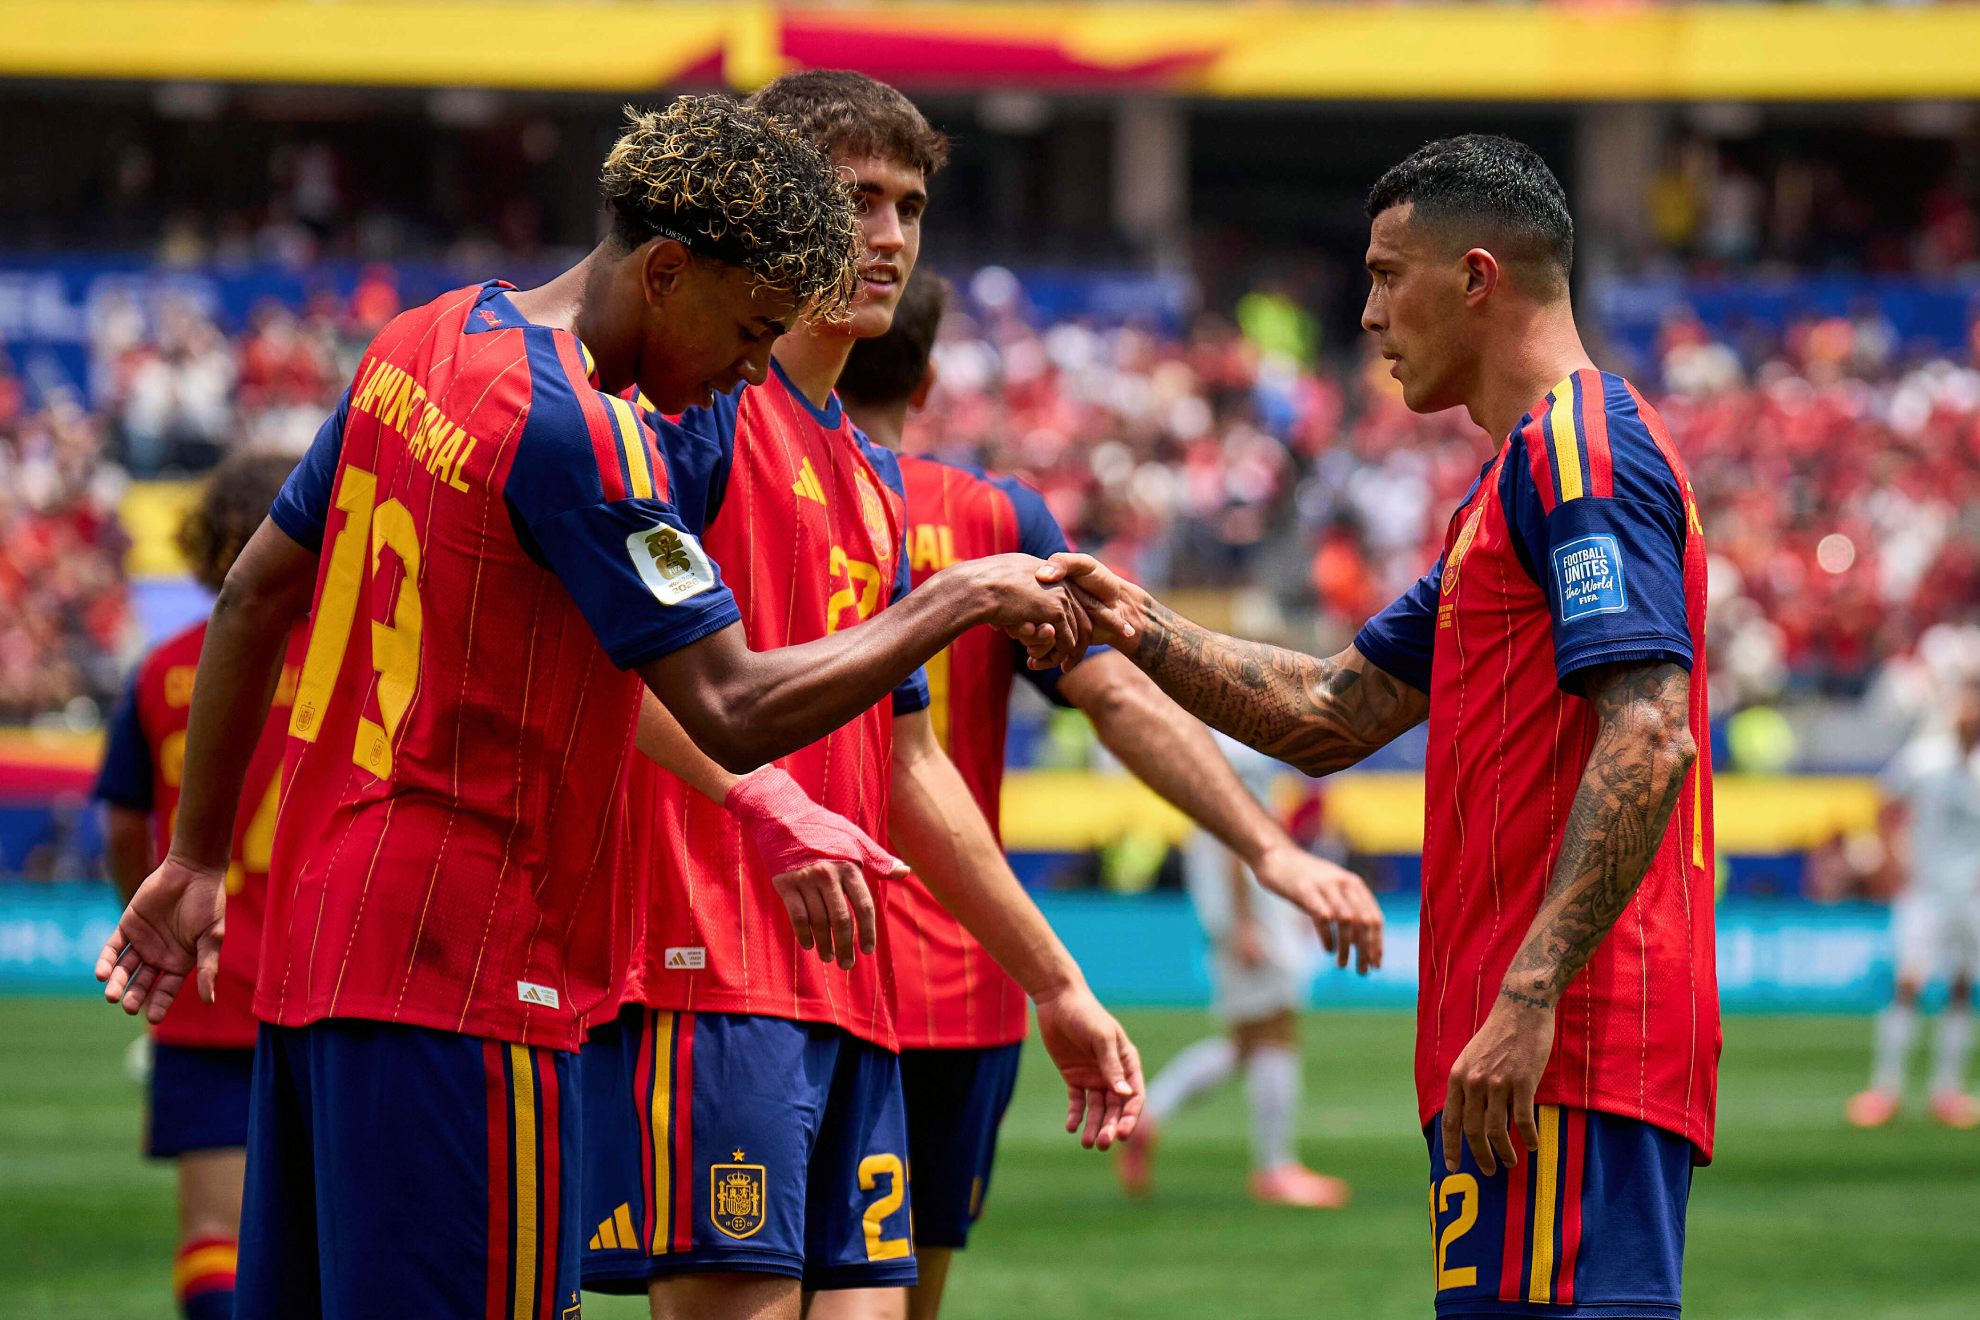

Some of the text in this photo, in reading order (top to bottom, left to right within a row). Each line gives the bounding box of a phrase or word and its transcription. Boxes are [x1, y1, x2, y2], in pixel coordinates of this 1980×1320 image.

[1563, 546, 1607, 568] FOOTBALL
[1565, 559, 1609, 585] UNITES
[1564, 575, 1614, 600] the World
[1578, 593, 1599, 605] FIFA
